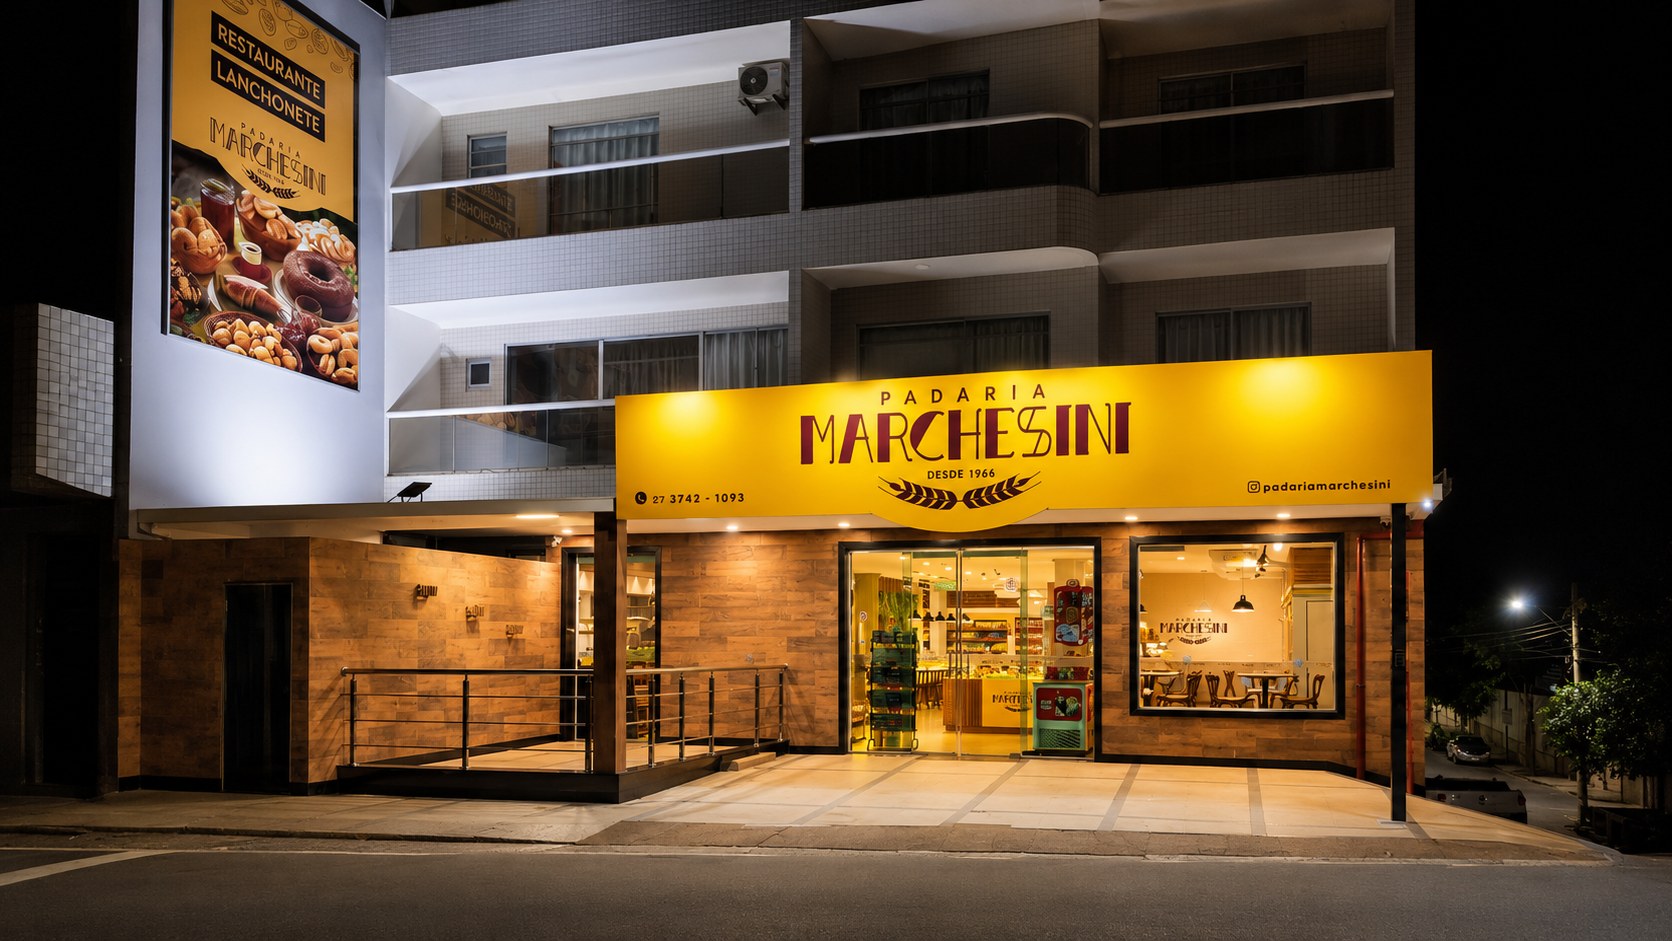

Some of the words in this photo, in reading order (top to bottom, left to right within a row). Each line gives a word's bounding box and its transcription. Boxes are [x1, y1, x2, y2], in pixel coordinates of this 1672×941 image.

[218, 23, 320, 100] RESTAURANTE
[217, 60, 320, 133] LANCHONETE
[209, 116, 326, 195] MARCHESINI
[241, 122, 300, 159] PADARIA
[880, 383, 1045, 406] PADARIA
[800, 402, 1132, 464] MARCHESINI
[927, 470, 964, 480] DESDE
[968, 468, 995, 479] 1966
[1263, 479, 1391, 494] padariamarchesini
[652, 495, 665, 504] 27
[669, 494, 700, 504] 3742
[715, 492, 745, 503] 1093
